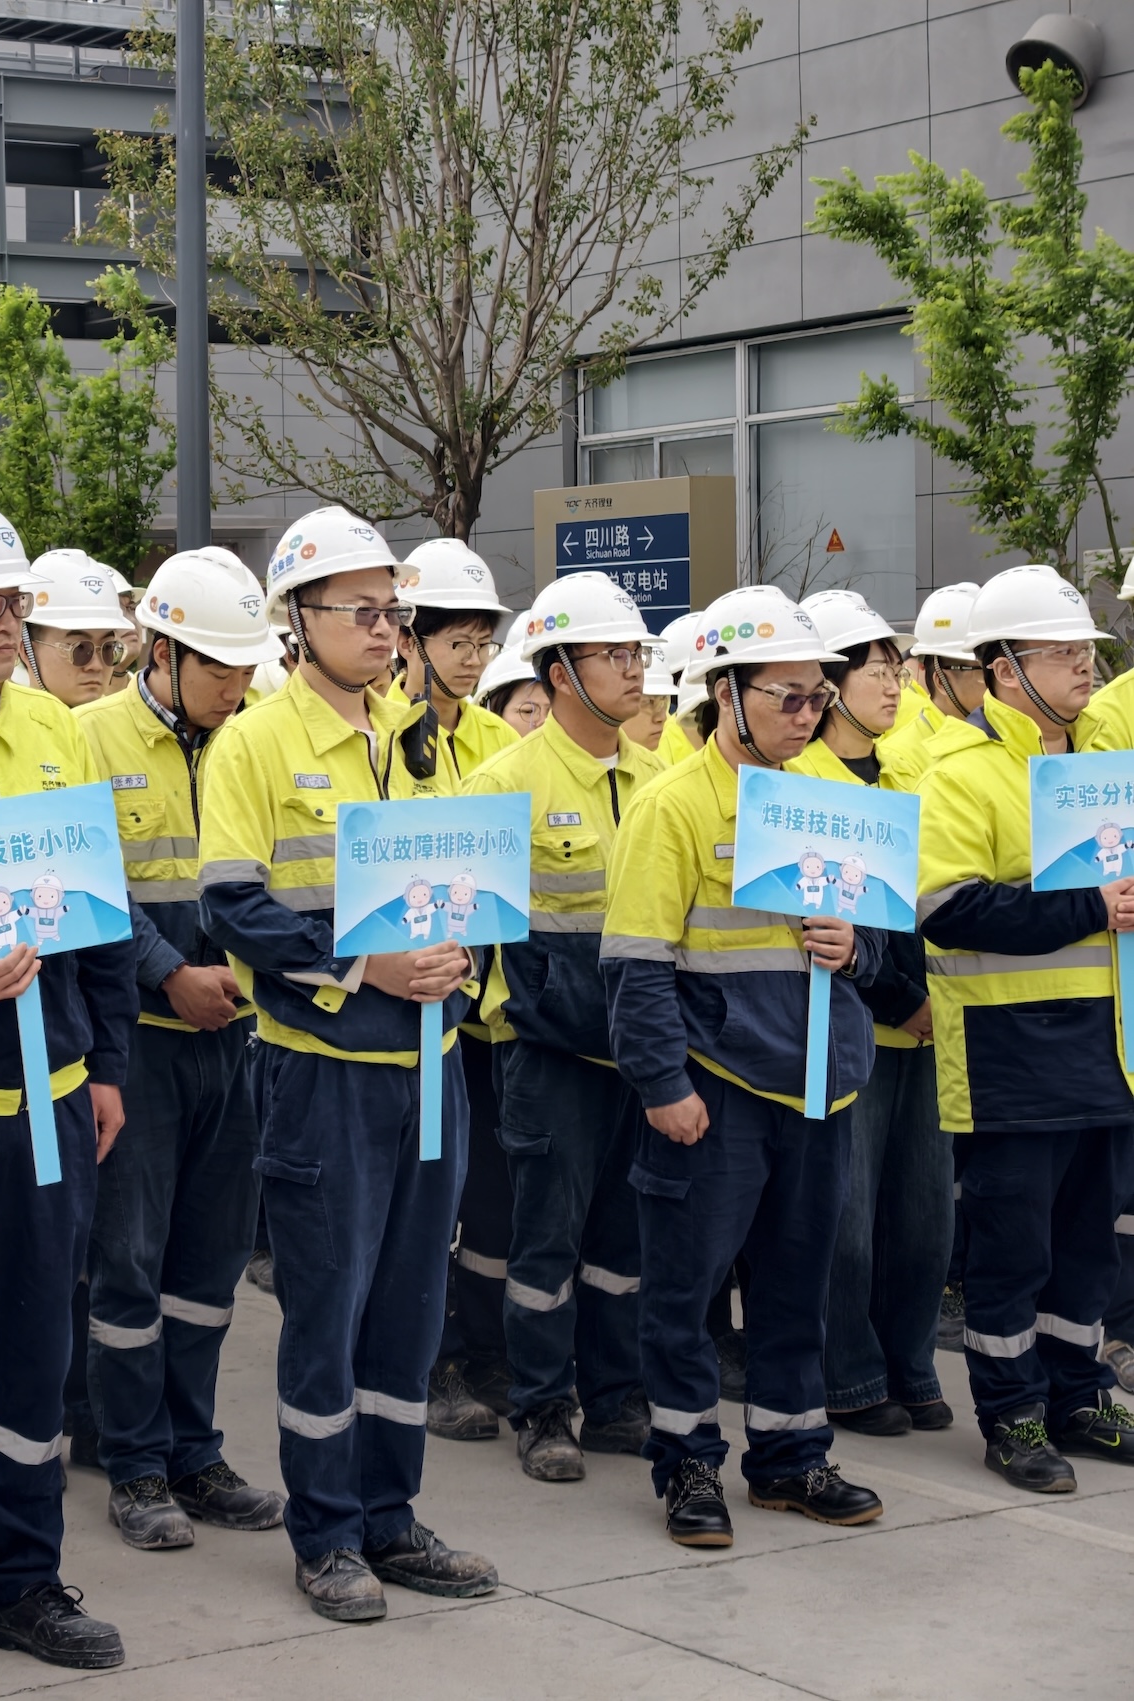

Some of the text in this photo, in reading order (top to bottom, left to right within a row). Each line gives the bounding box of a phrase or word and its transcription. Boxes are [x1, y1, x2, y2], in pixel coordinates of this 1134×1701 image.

[585, 524, 630, 548] 四川路
[586, 547, 631, 559] Sichuan Road
[114, 776, 145, 787] 张希文
[762, 802, 896, 848] 焊接技能小队
[350, 827, 519, 865] 电仪故障排除小队
